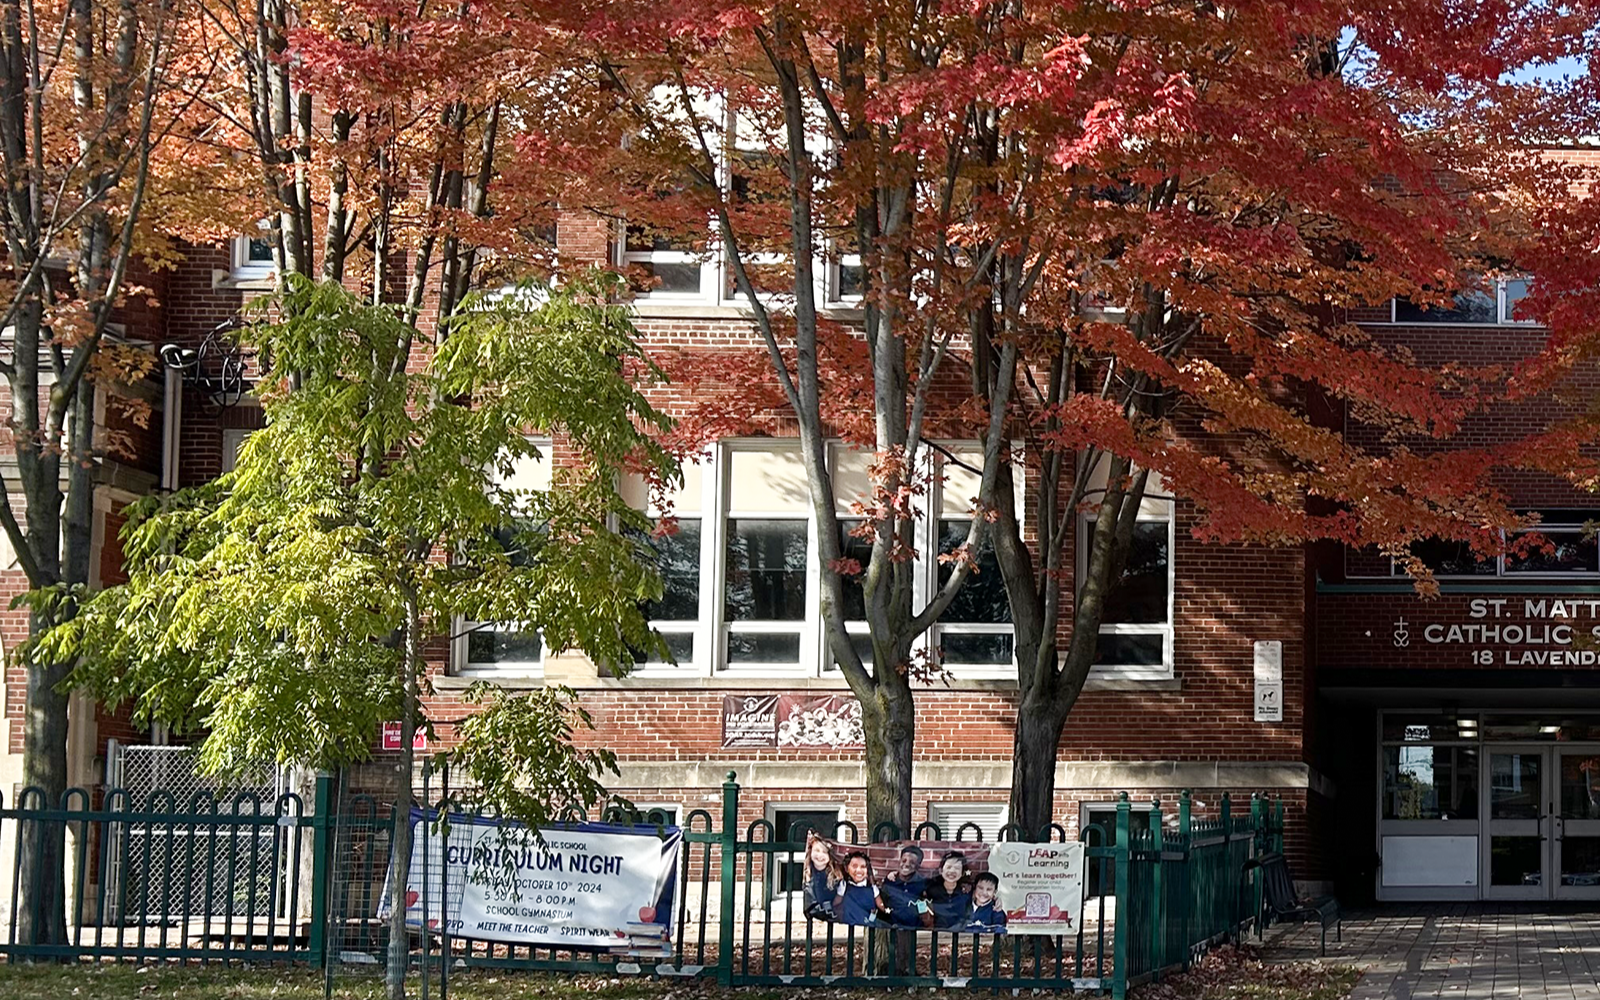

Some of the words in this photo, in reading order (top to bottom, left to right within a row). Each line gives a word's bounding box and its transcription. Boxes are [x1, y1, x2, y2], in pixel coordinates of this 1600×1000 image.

[1469, 599, 1511, 618] ST.
[1424, 624, 1572, 644] CATHOLIC
[1471, 651, 1494, 665] 18
[726, 713, 776, 722] IMAGINE
[560, 841, 588, 851] SCHOOL
[1029, 848, 1058, 858] LEAP
[569, 854, 624, 876] NIGHT
[1028, 858, 1069, 869] Learning
[515, 878, 554, 890] OCTOBER
[577, 881, 602, 893] 2024
[486, 905, 519, 916] SCHOOL
[521, 907, 573, 919] GYMNASIUM
[477, 921, 497, 932] MEET
[499, 922, 513, 932] THE
[514, 923, 549, 934] TEACHER
[560, 926, 586, 936] SPIRIT
[588, 926, 610, 937] WEAR
